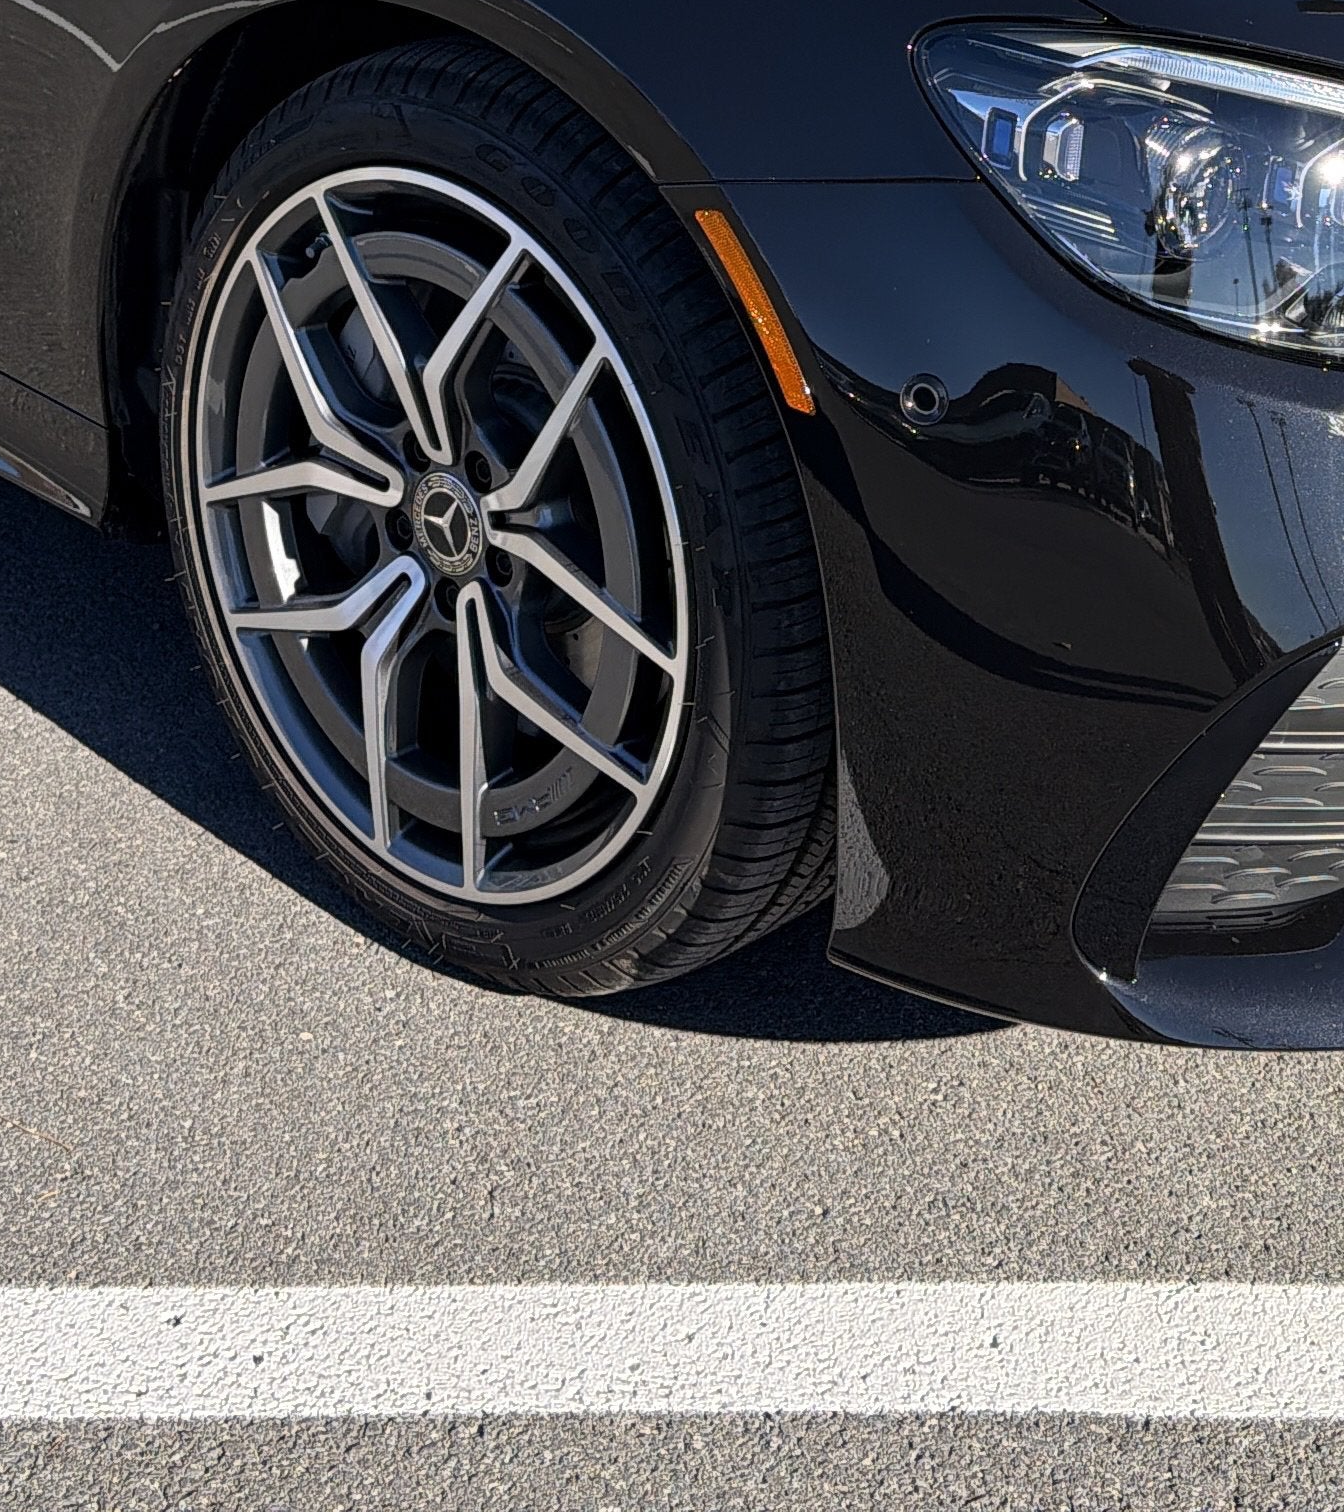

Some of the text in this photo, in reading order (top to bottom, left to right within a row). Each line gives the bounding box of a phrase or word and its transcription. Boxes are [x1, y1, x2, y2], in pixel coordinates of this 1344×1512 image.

[474, 142, 737, 618] GOODYEAR
[413, 483, 481, 553] MERCEDES BENZ
